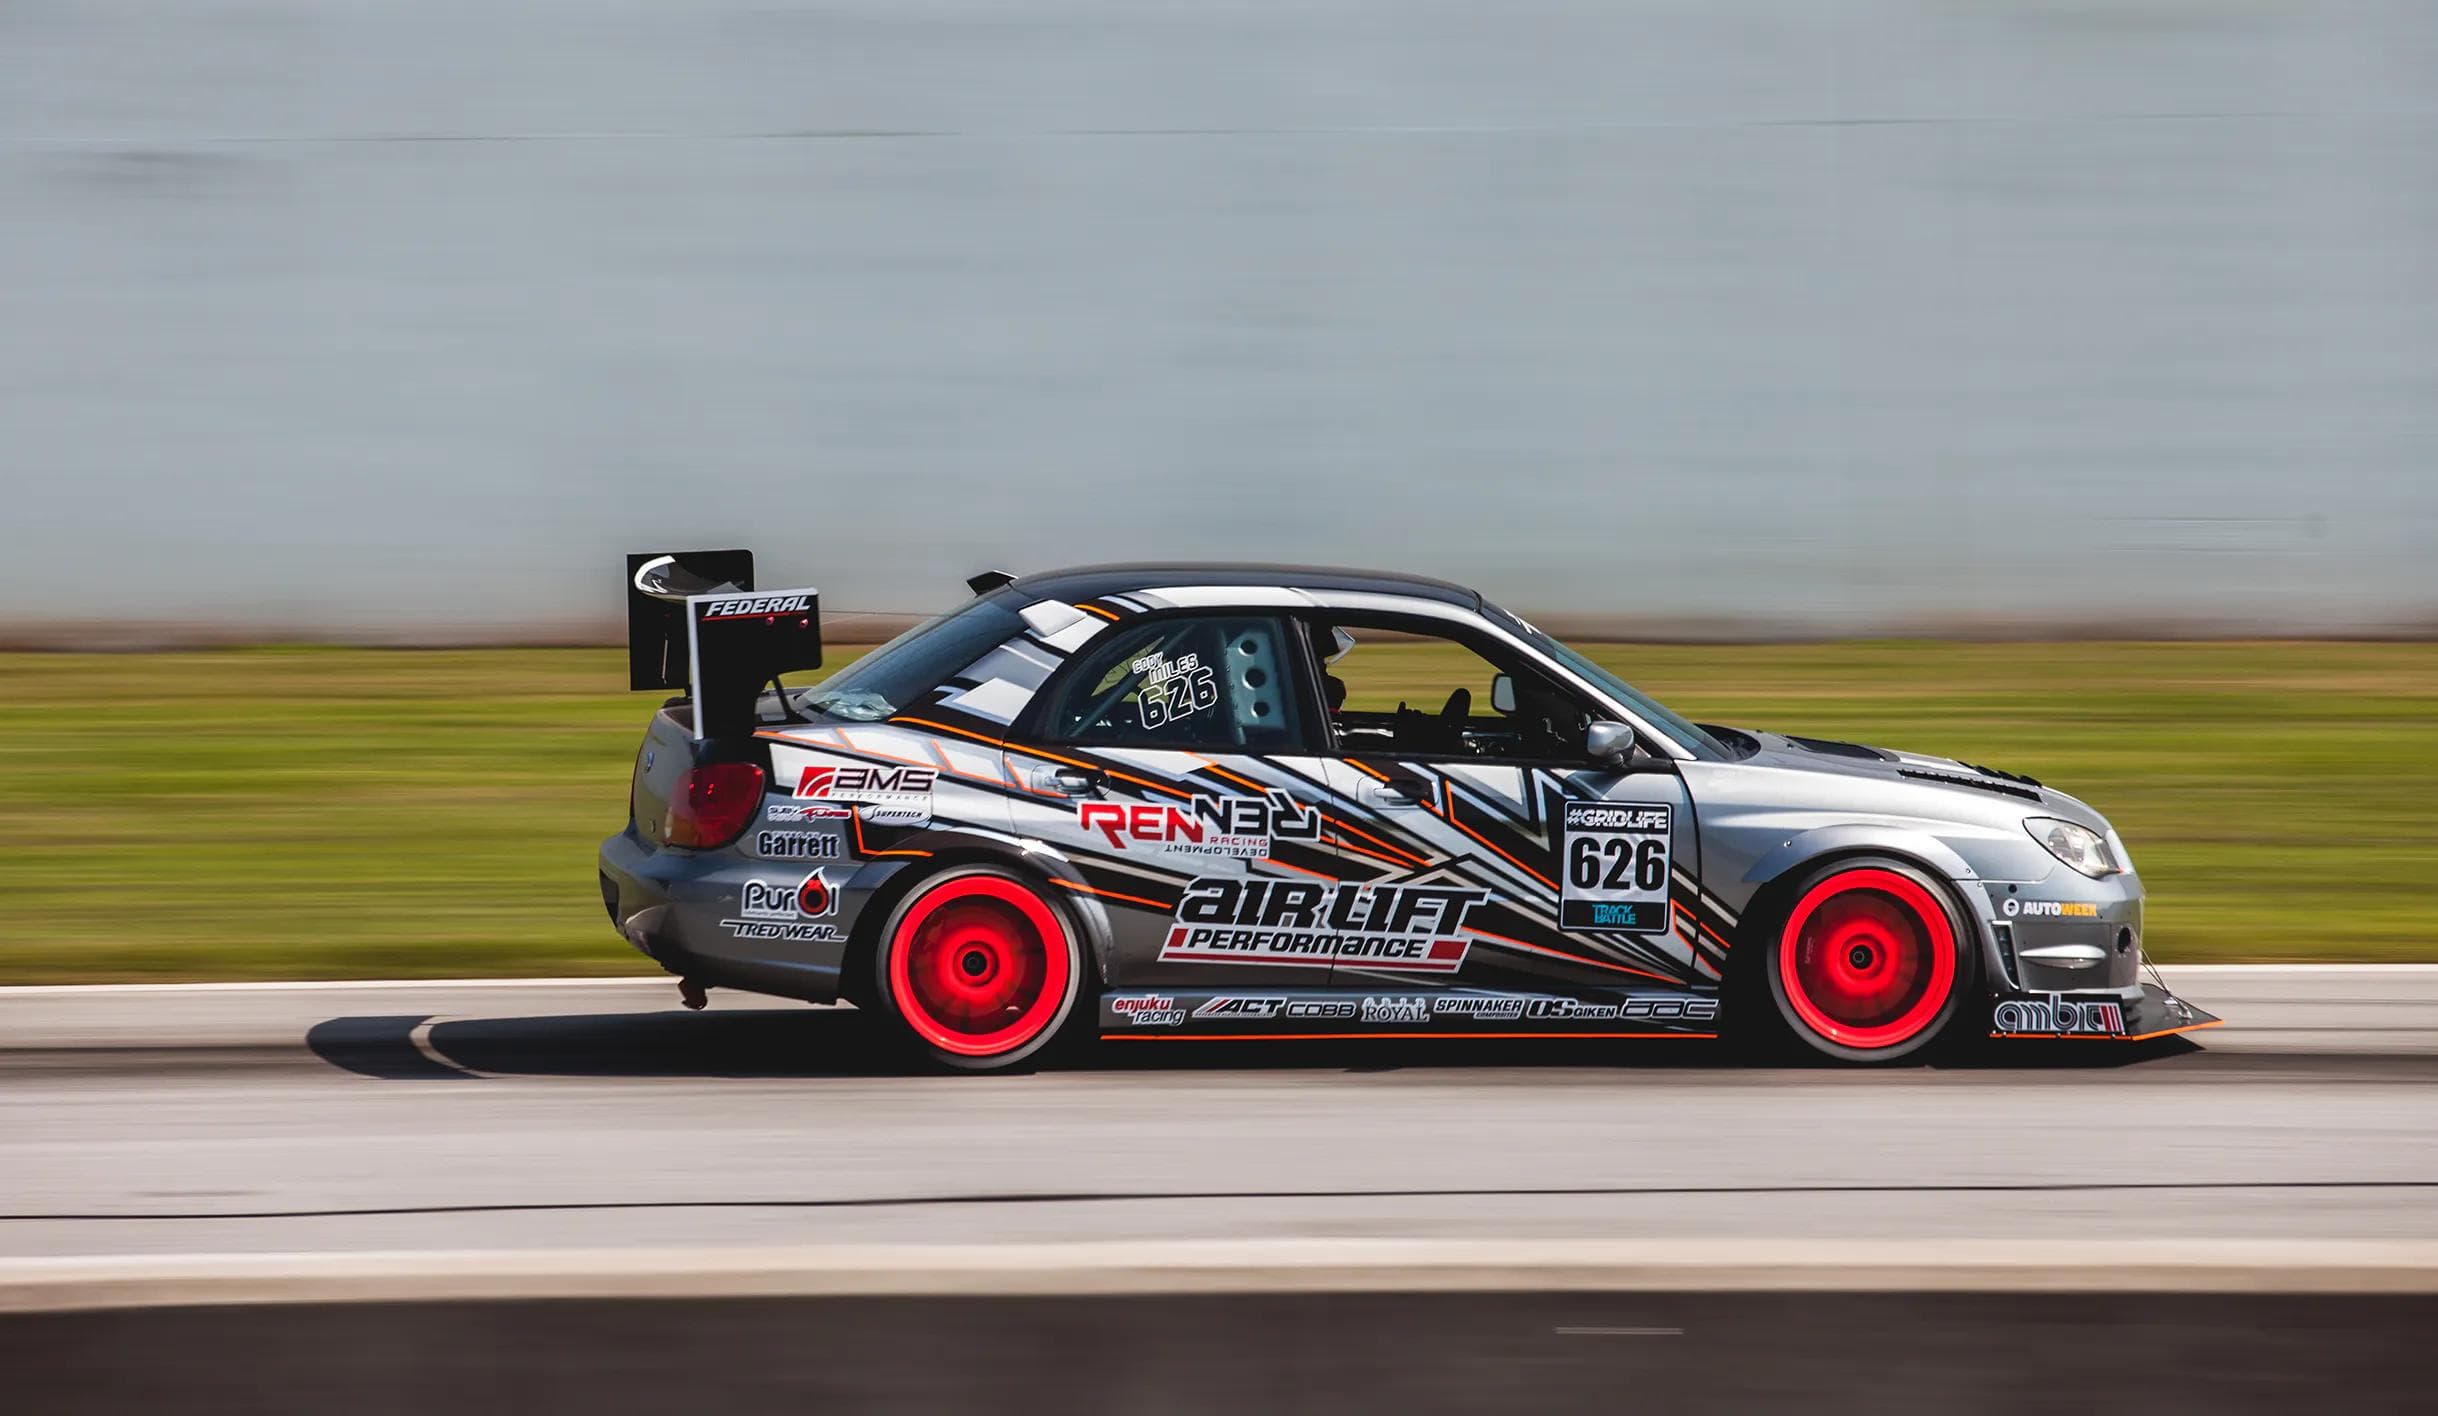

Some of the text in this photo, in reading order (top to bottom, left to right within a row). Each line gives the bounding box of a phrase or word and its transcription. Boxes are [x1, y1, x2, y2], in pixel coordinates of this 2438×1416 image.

[705, 596, 811, 617] FEDERAL
[1132, 652, 1163, 674] CODY
[1149, 653, 1199, 685] MILES
[1138, 666, 1218, 730] 626
[834, 768, 935, 792] AMS
[869, 805, 923, 821] SUPERTECH
[1567, 808, 1667, 829] #GRIDLIFE
[759, 832, 838, 857] Garrett
[1209, 836, 1268, 847] RACING
[1164, 843, 1267, 857] DEVELOPMENT
[1569, 837, 1666, 891] 626
[1592, 903, 1633, 915] TRACK
[2023, 901, 2097, 917] AUTOWEEK
[1594, 913, 1637, 925] BATTLE
[1114, 996, 1171, 1011] enjuku
[1214, 998, 1285, 1013] ACT
[1288, 1003, 1355, 1016] COBB
[1436, 1000, 1523, 1013] SPINNAKER
[1528, 999, 1615, 1018] OS GIKEN
[1135, 1008, 1183, 1025] racing
[1364, 1005, 1428, 1021] ROYAL
